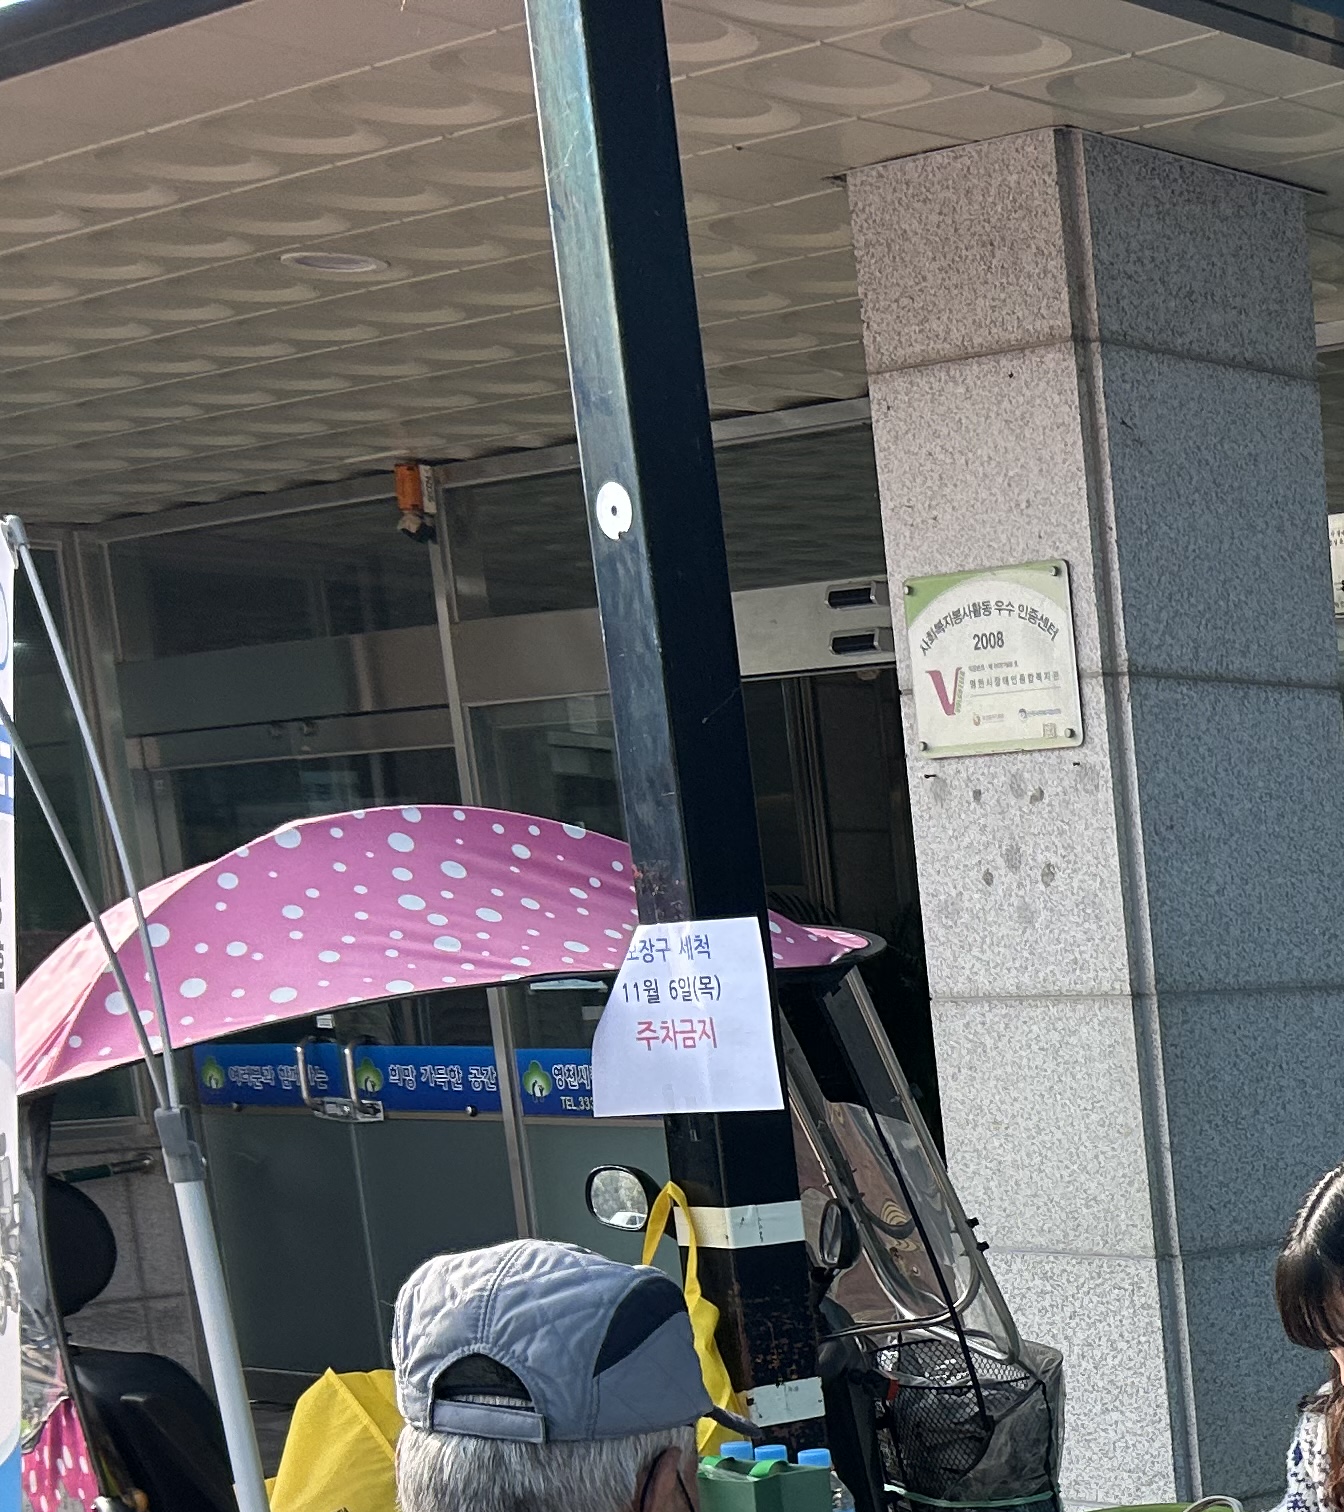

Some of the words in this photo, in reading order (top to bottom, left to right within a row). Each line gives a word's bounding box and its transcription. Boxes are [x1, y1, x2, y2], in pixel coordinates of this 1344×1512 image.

[994, 600, 1015, 617] 우수
[1018, 603, 1060, 641] 인증센터
[972, 631, 1004, 651] 2008
[678, 934, 711, 960] 세척
[622, 978, 661, 1004] 11월
[668, 974, 722, 1003] 6일(목)
[636, 1017, 718, 1051] 주차금지
[388, 1064, 416, 1091] 희망
[420, 1065, 463, 1091] 가득한
[468, 1065, 497, 1092] 공간
[552, 1064, 593, 1090] 영천시
